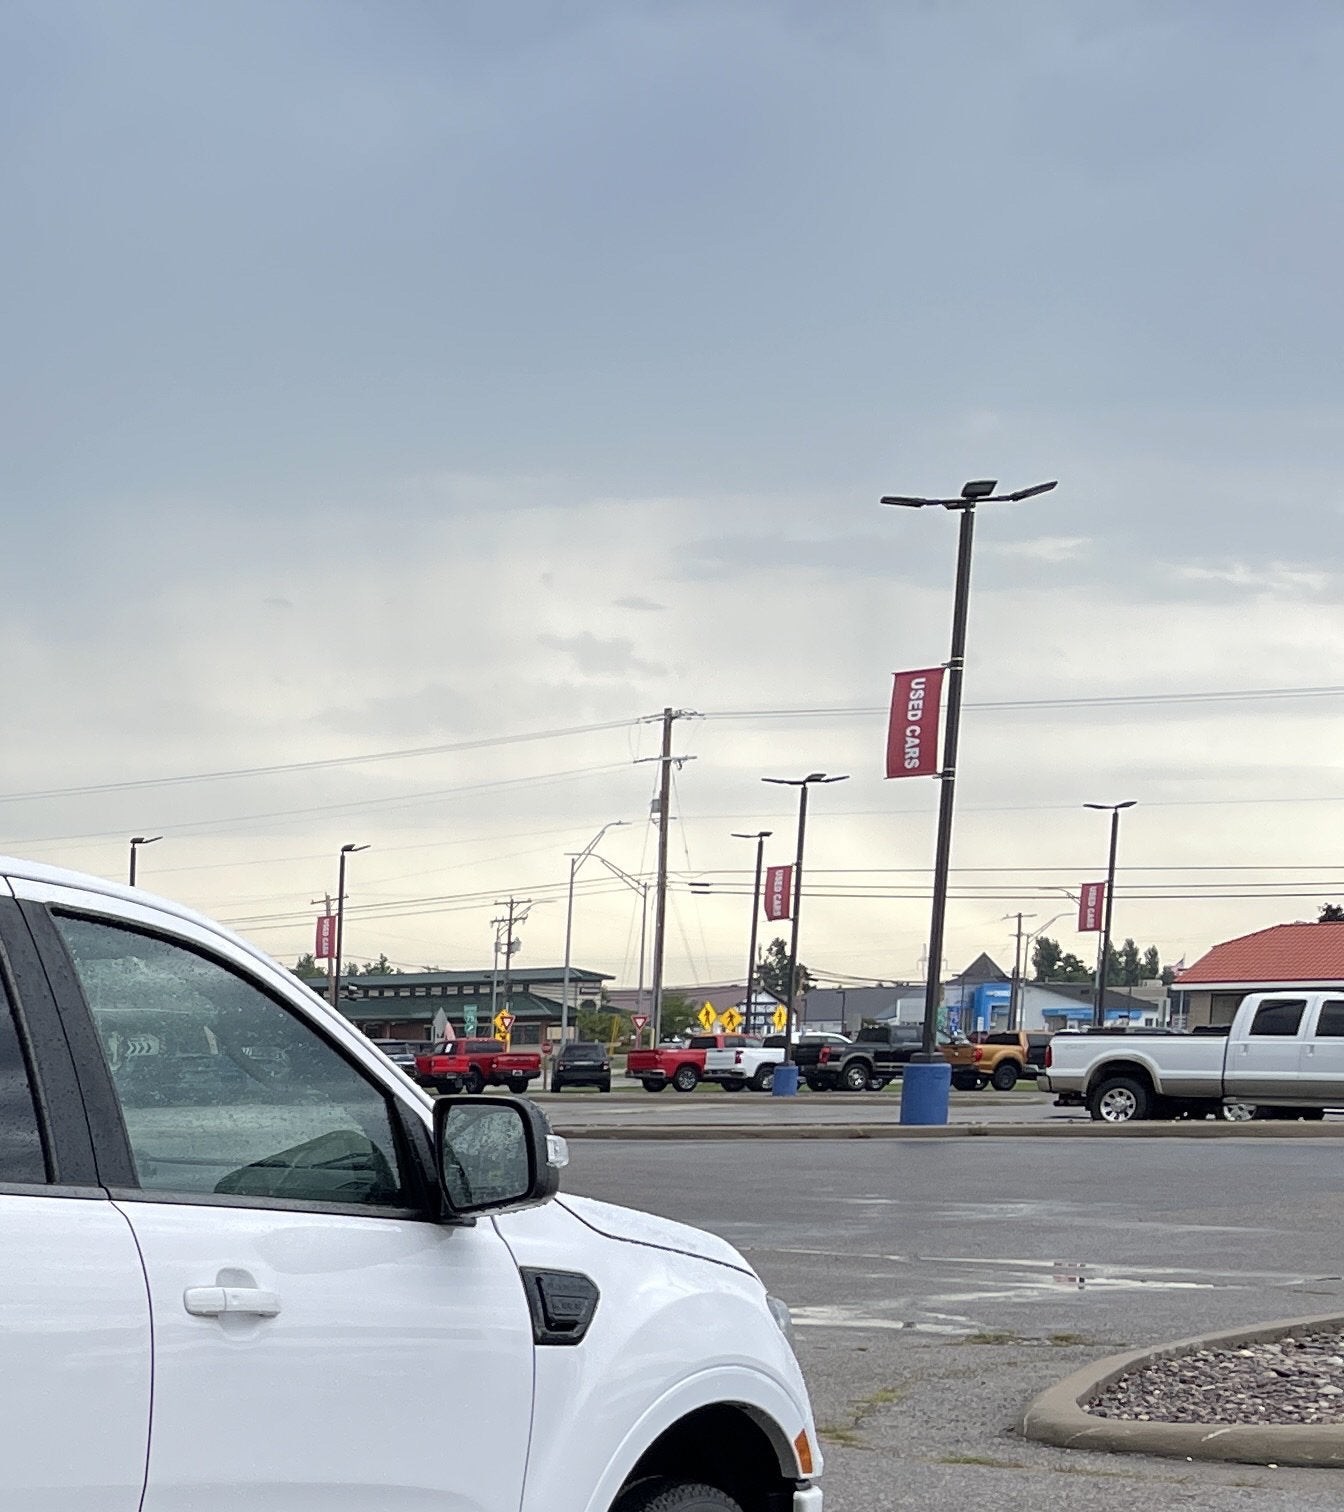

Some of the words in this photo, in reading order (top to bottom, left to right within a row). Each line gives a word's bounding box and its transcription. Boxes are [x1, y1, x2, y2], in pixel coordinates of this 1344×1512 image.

[907, 677, 926, 721] USED
[904, 725, 921, 769] CARS
[774, 869, 784, 892] USED
[773, 894, 782, 916] CARS
